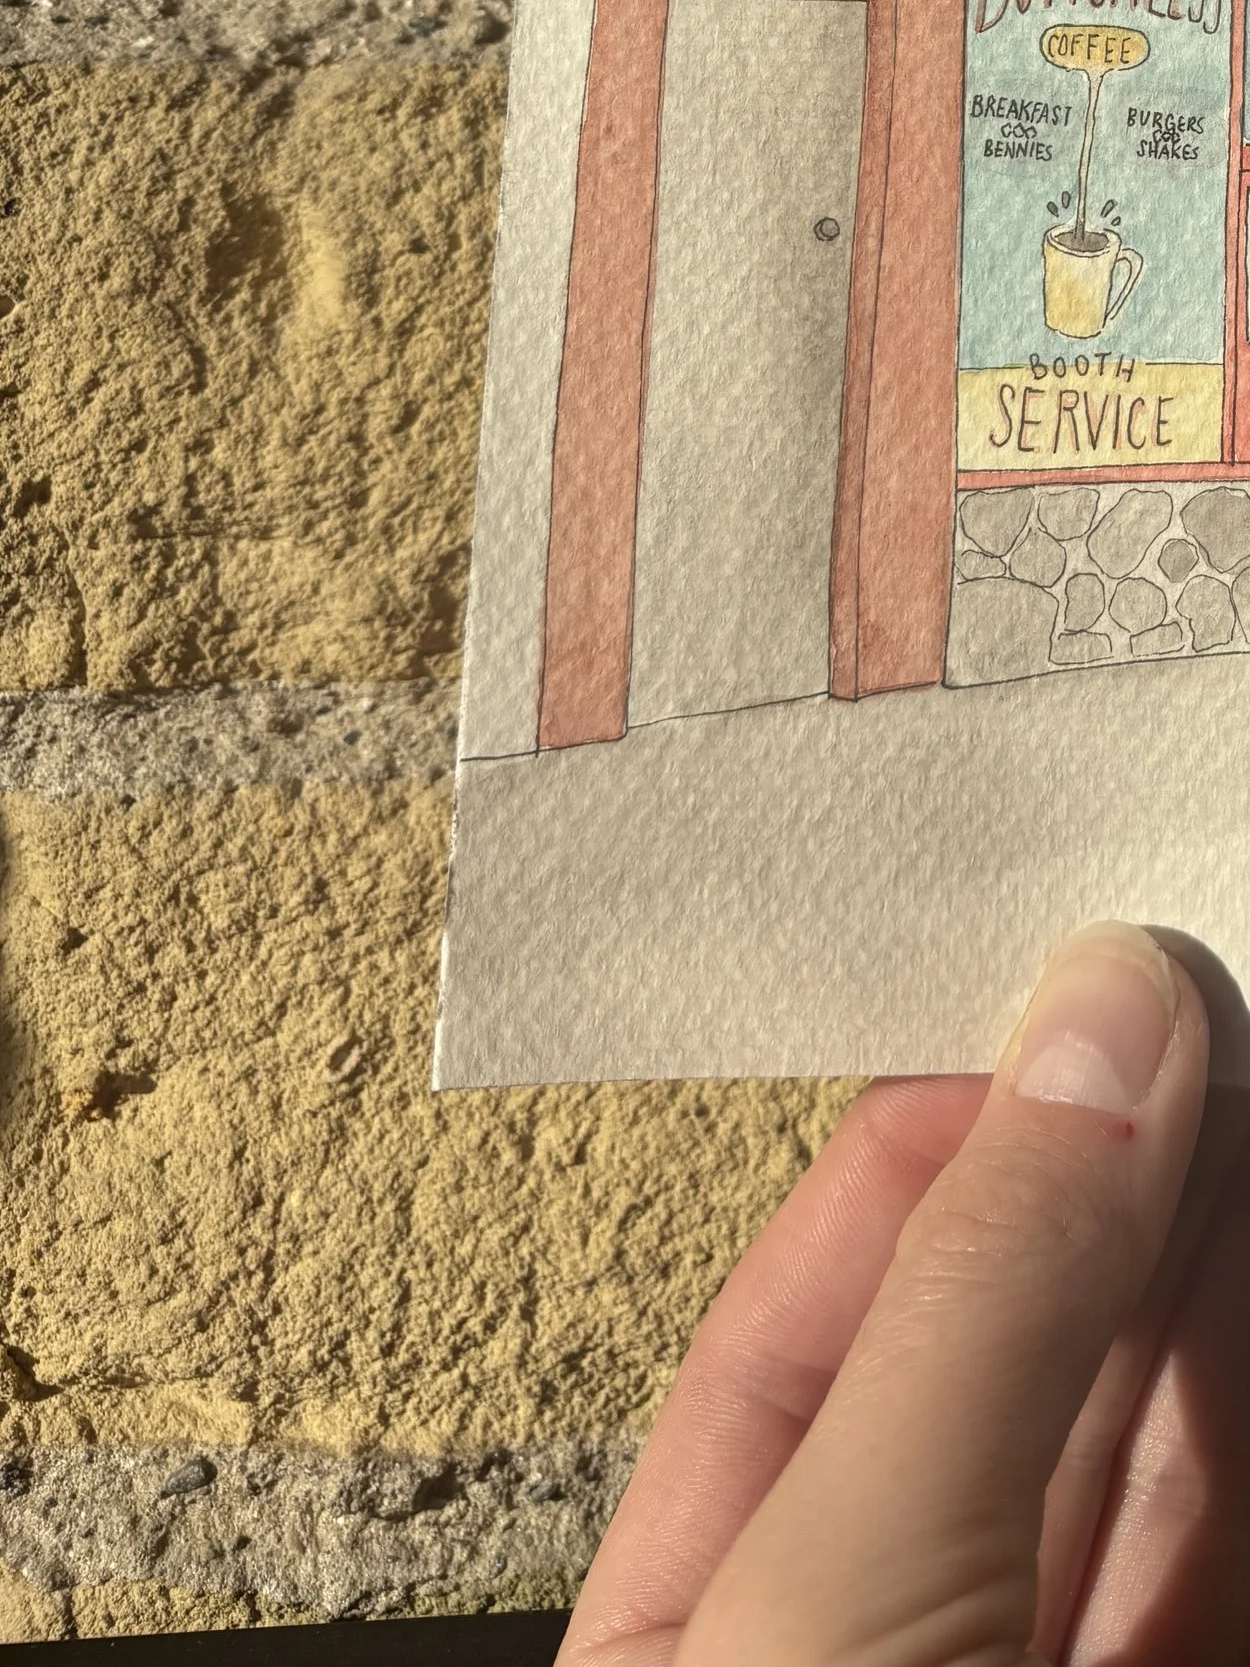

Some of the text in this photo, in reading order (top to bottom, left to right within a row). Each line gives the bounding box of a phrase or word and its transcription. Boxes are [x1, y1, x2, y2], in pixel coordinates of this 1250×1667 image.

[1047, 33, 1133, 65] COFFEE
[970, 94, 1072, 127] BREAKFAST
[1126, 106, 1206, 135] BURGERS
[983, 138, 1054, 162] BENNIES
[1136, 138, 1200, 161] SHAKES
[1029, 351, 1136, 383] BOOTH
[988, 383, 1175, 455] SERVICE
